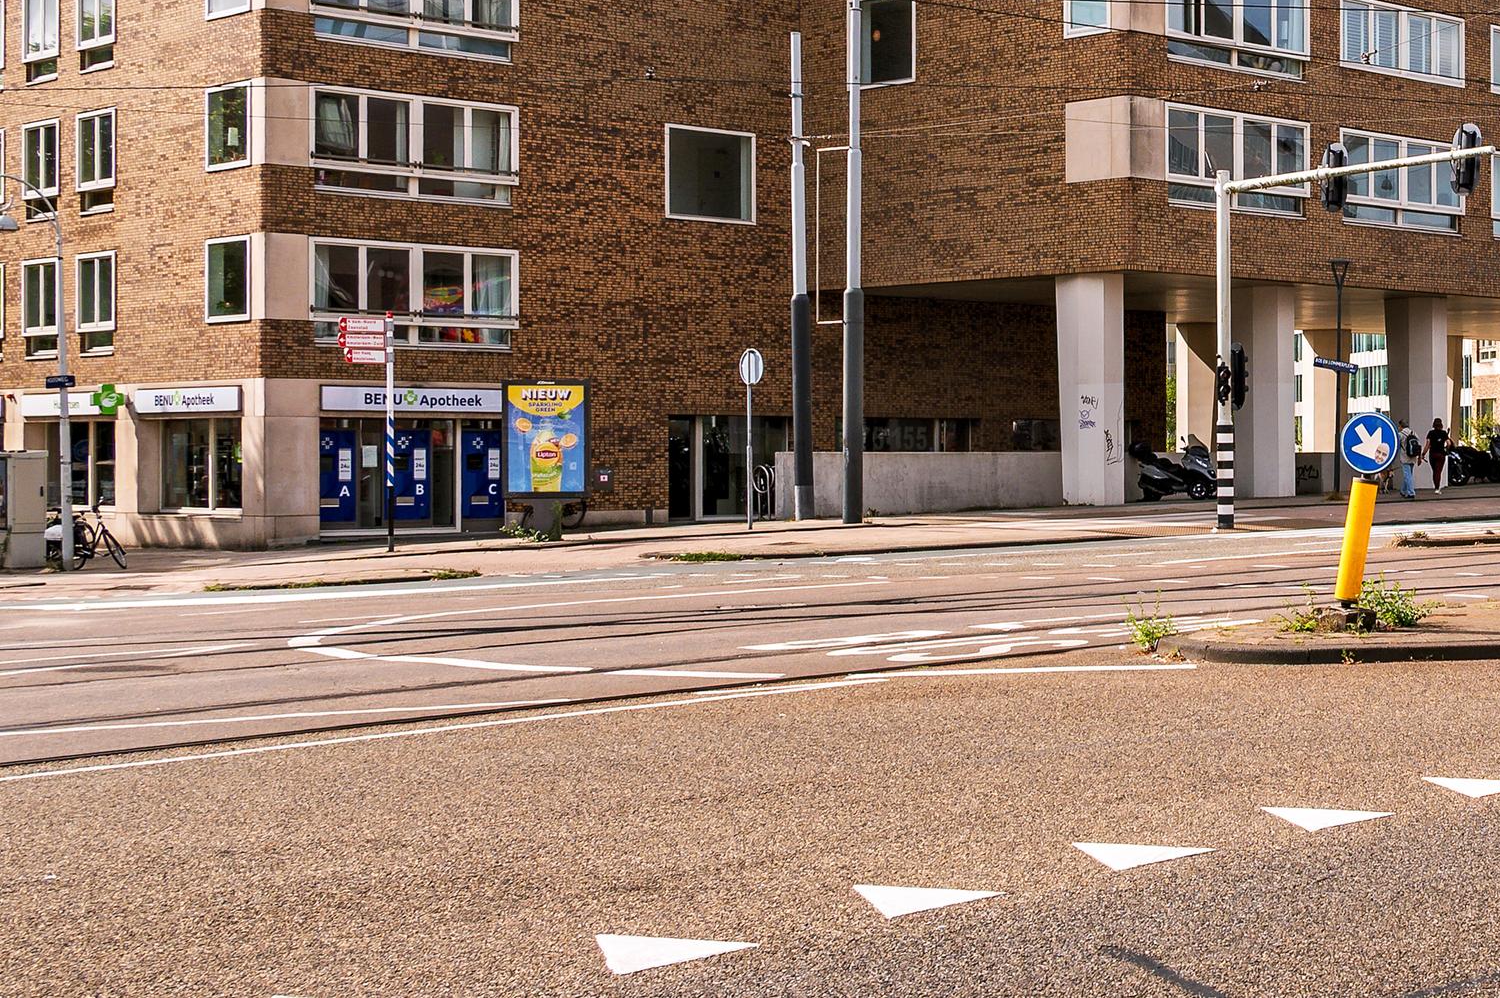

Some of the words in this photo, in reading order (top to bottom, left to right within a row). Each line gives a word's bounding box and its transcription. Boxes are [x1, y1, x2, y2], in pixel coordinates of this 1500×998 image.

[521, 388, 572, 400] NIEUW
[154, 394, 173, 407] BENU
[181, 393, 215, 408] Apotheek
[419, 395, 483, 408] Apotheek
[537, 451, 557, 459] Lipton
[339, 485, 351, 497] A
[415, 484, 424, 495] B
[488, 484, 497, 495] C
